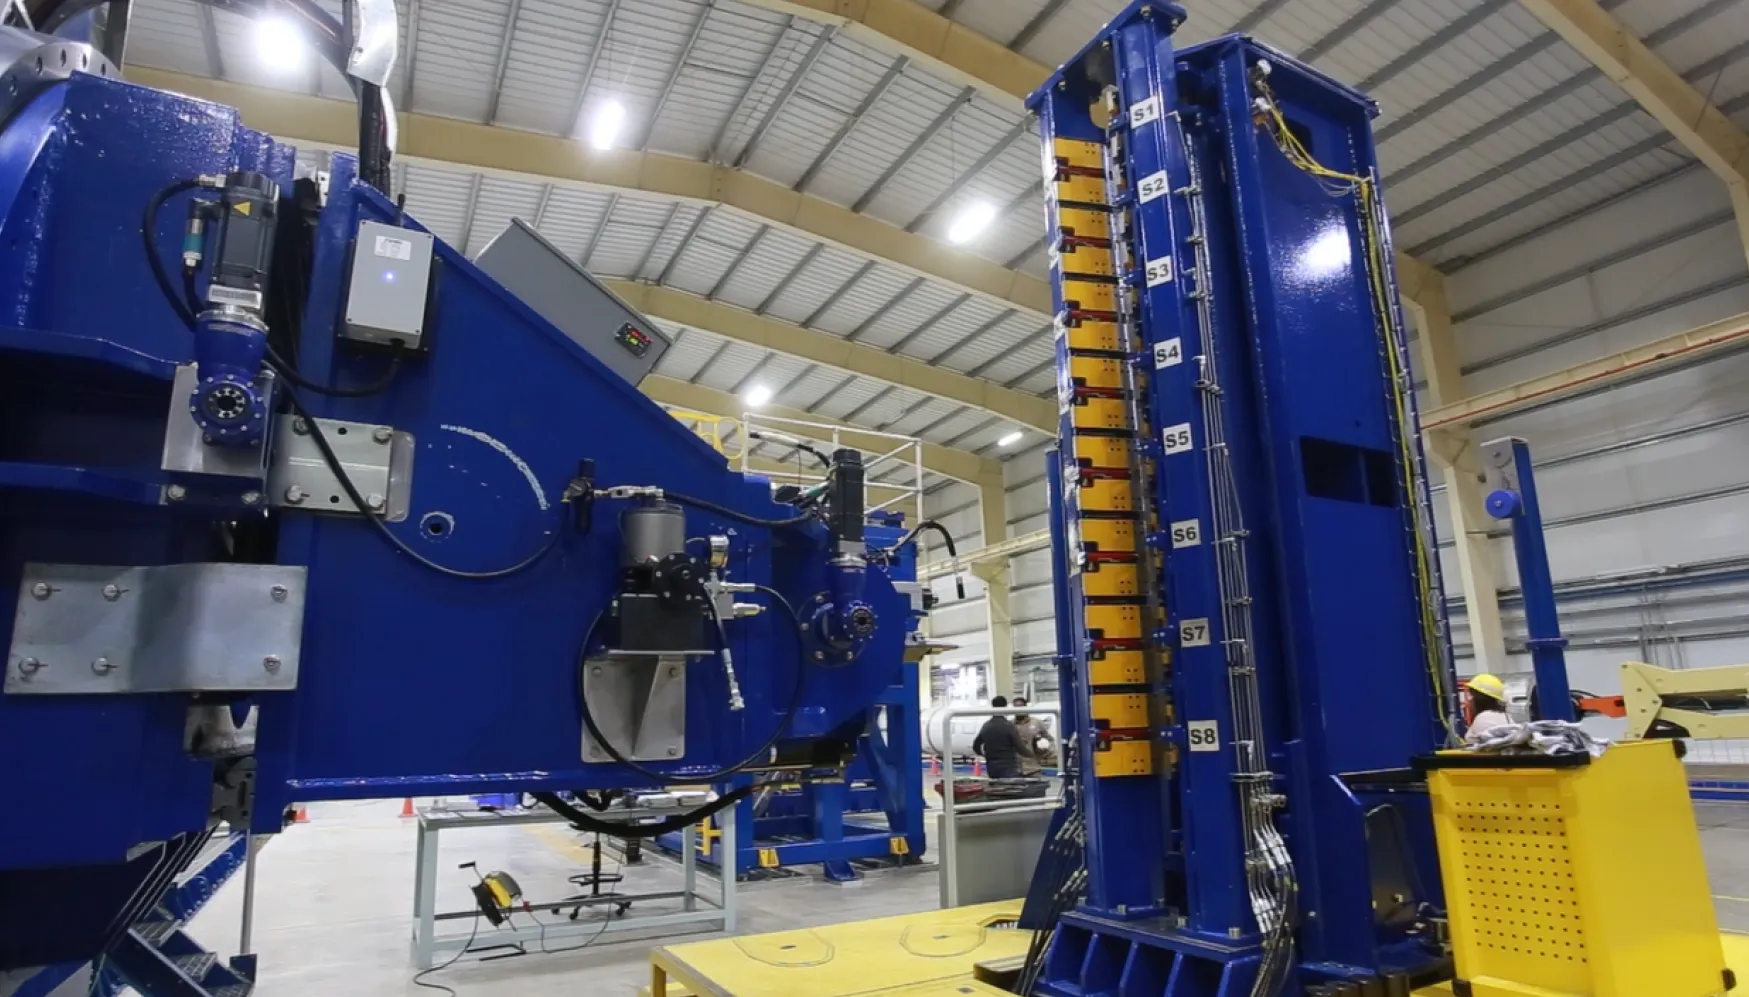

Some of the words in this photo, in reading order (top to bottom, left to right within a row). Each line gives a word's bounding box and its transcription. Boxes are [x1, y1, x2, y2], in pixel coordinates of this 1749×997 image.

[1133, 104, 1154, 122] S1
[1142, 177, 1164, 197] S2
[1147, 263, 1169, 282] S3
[1156, 345, 1179, 364] S4
[1165, 430, 1189, 449] S5
[1173, 526, 1197, 543] S6
[1182, 625, 1206, 642] S7
[1190, 728, 1216, 745] S8
